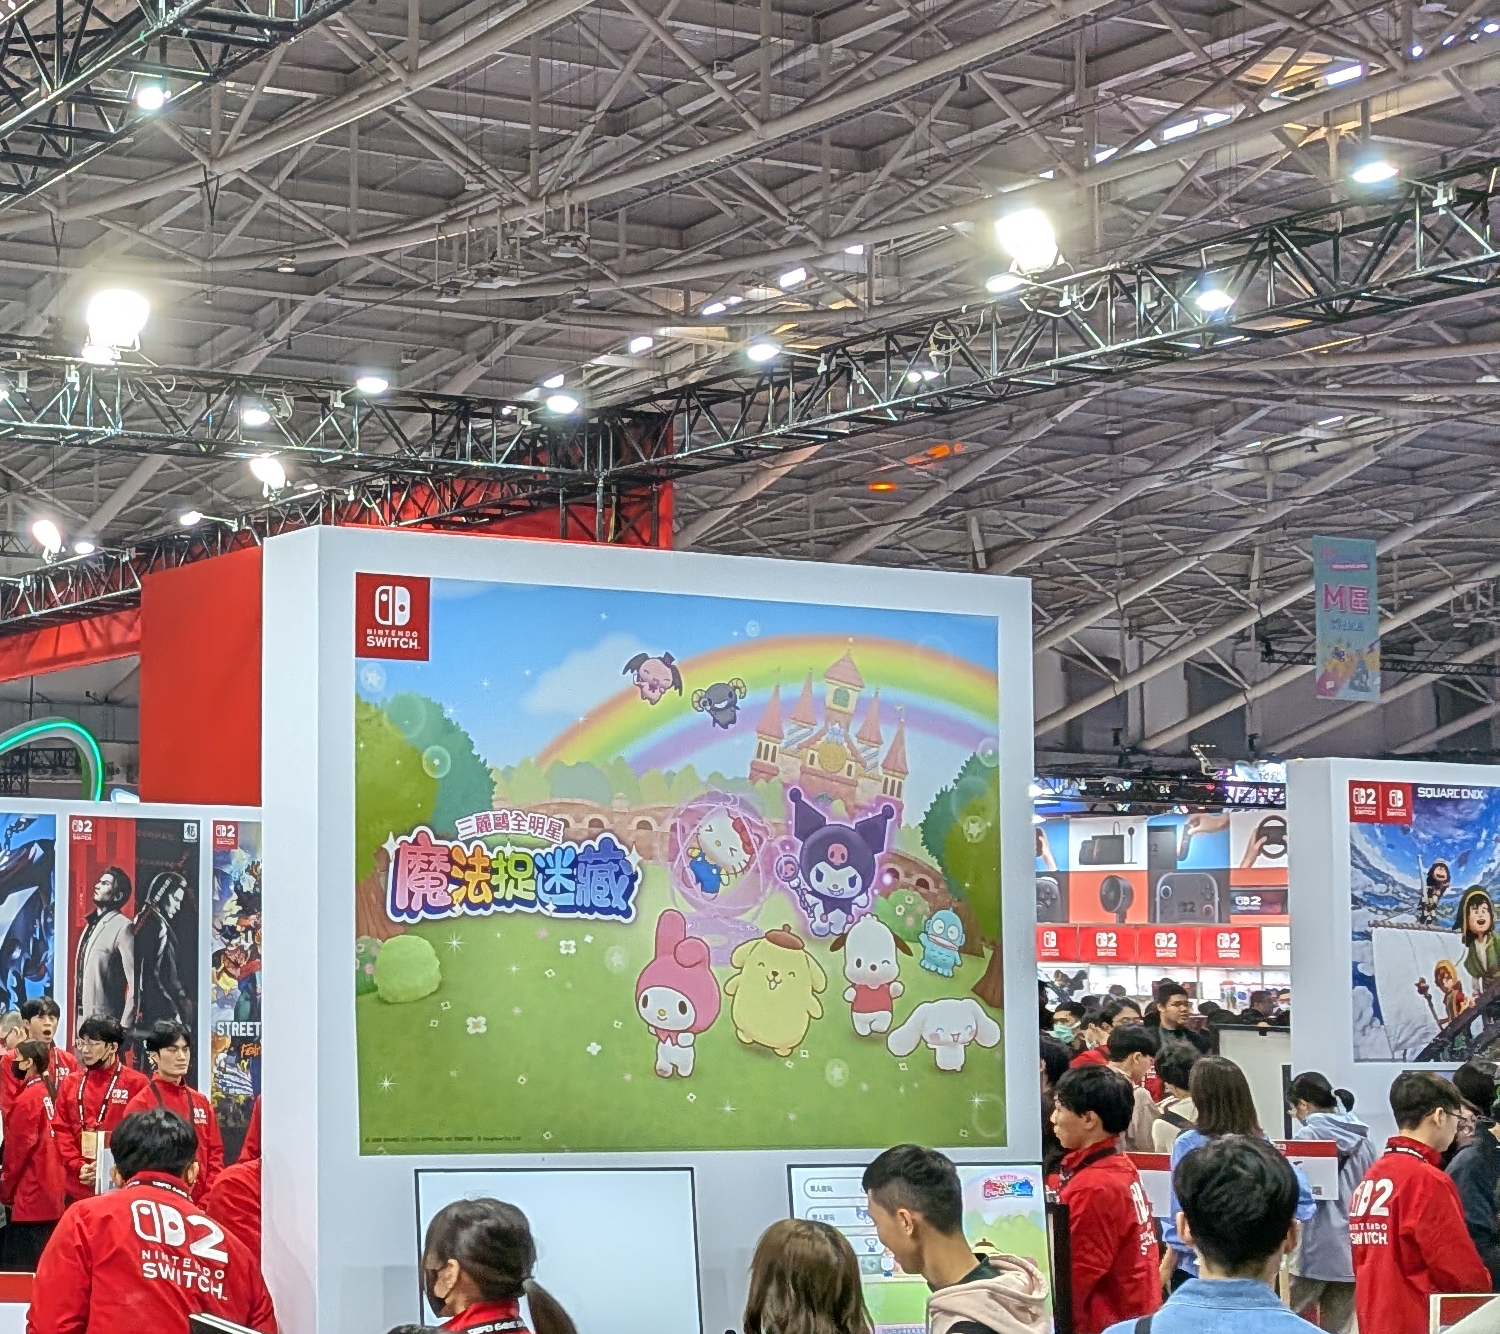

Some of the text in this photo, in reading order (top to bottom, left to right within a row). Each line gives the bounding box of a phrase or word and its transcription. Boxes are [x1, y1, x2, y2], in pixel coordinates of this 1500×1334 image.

[366, 635, 420, 650] SWITCH
[393, 827, 637, 913] 魔法捉迷藏
[216, 1021, 261, 1037] STREET
[1370, 1178, 1394, 1217] 2
[186, 1214, 229, 1264] 2
[141, 1249, 225, 1279] NINTENDO
[142, 1261, 224, 1300] SWITCH
